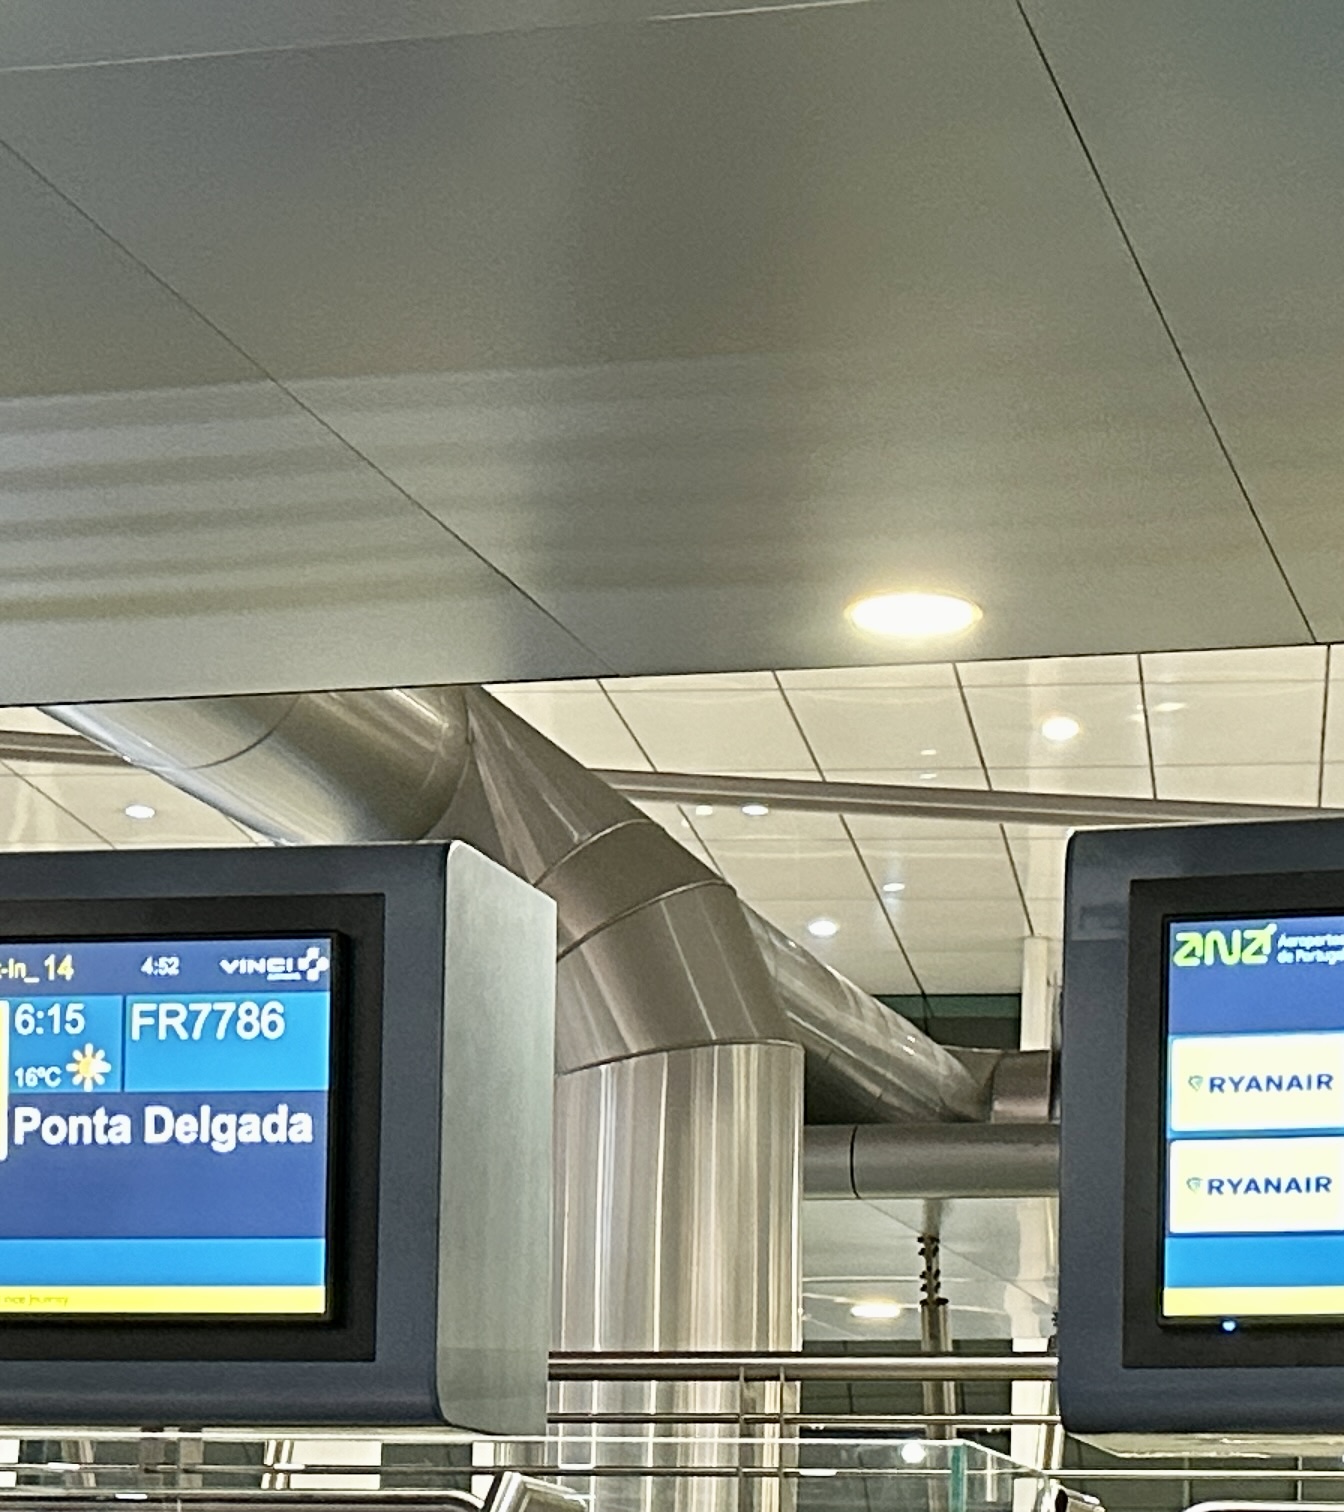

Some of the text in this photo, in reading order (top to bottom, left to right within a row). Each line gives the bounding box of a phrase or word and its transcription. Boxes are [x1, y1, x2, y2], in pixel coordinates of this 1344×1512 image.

[45, 954, 74, 980] 14
[141, 956, 180, 976] 4:52
[219, 958, 293, 974] VINCI
[15, 1004, 85, 1036] 6:15
[131, 1001, 285, 1040] FR7786
[1209, 1073, 1333, 1093] RYANAIR
[15, 1103, 313, 1153] Ponta Delgada
[1207, 1176, 1332, 1195] RYANAIR
